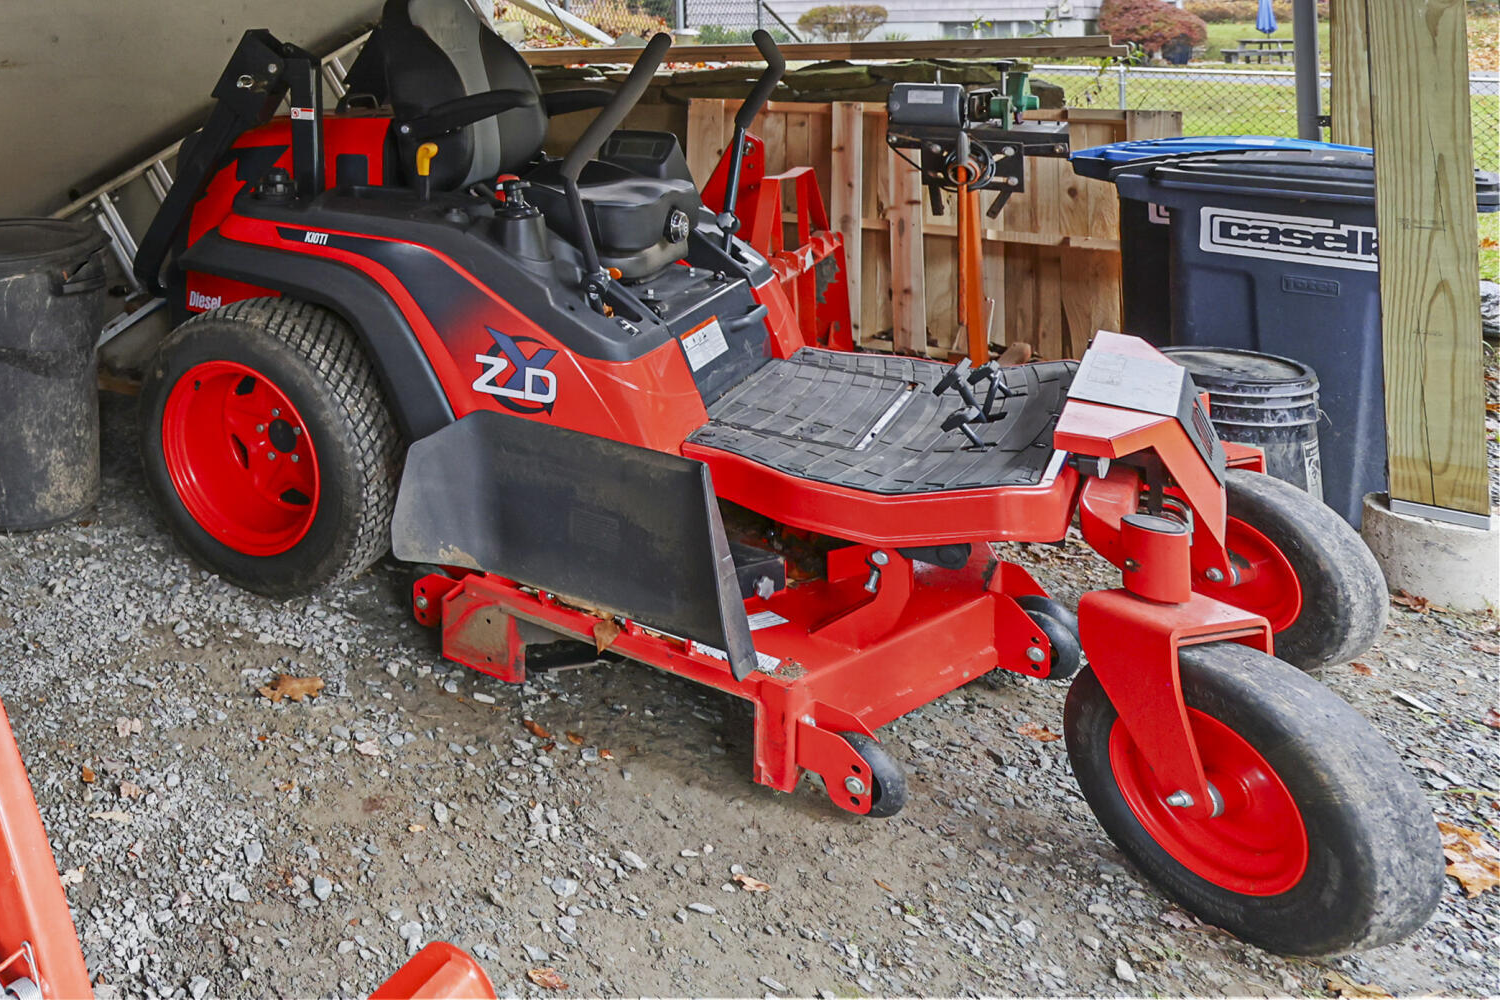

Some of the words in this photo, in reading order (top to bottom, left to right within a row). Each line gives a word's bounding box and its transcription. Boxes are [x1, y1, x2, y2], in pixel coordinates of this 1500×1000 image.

[304, 231, 329, 246] KIOTI
[1218, 220, 1378, 256] casell
[189, 290, 222, 310] Diesel
